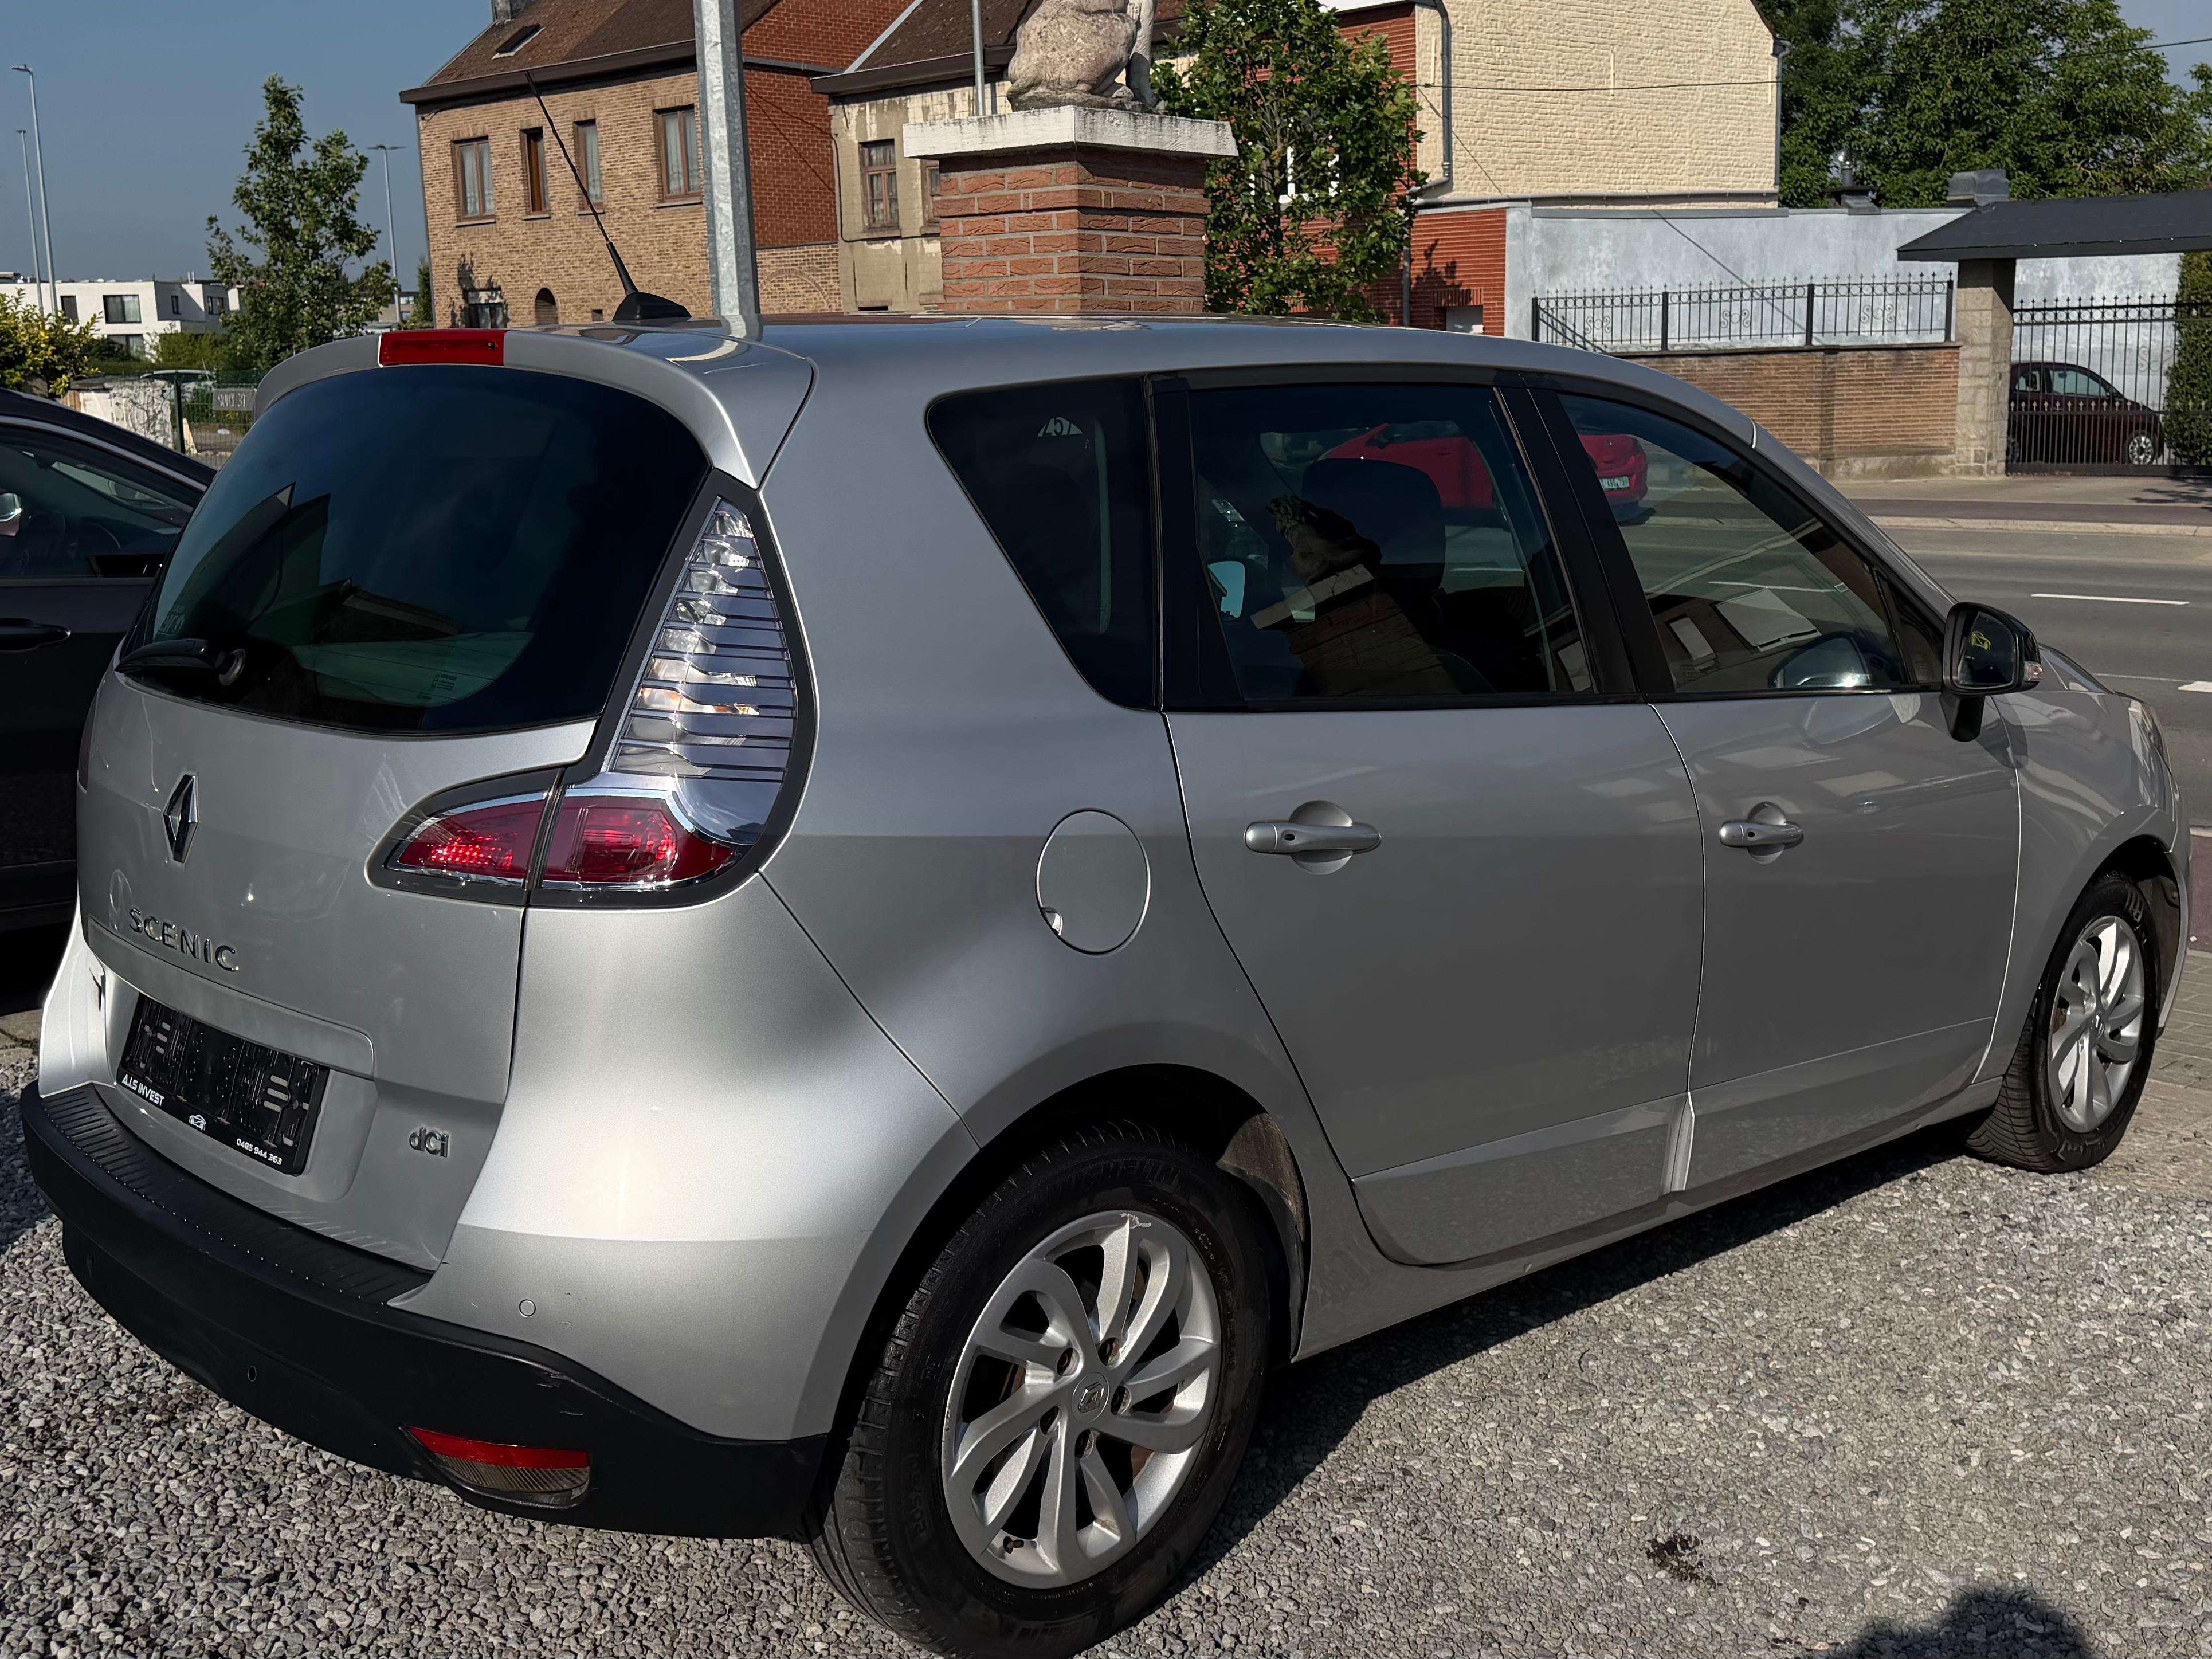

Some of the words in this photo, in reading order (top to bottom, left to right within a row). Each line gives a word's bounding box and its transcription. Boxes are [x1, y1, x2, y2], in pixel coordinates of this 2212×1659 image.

[129, 907, 240, 972] SCENIC
[138, 1083, 165, 1107] INVEST
[253, 1146, 268, 1159] 944
[268, 1153, 283, 1165] 363
